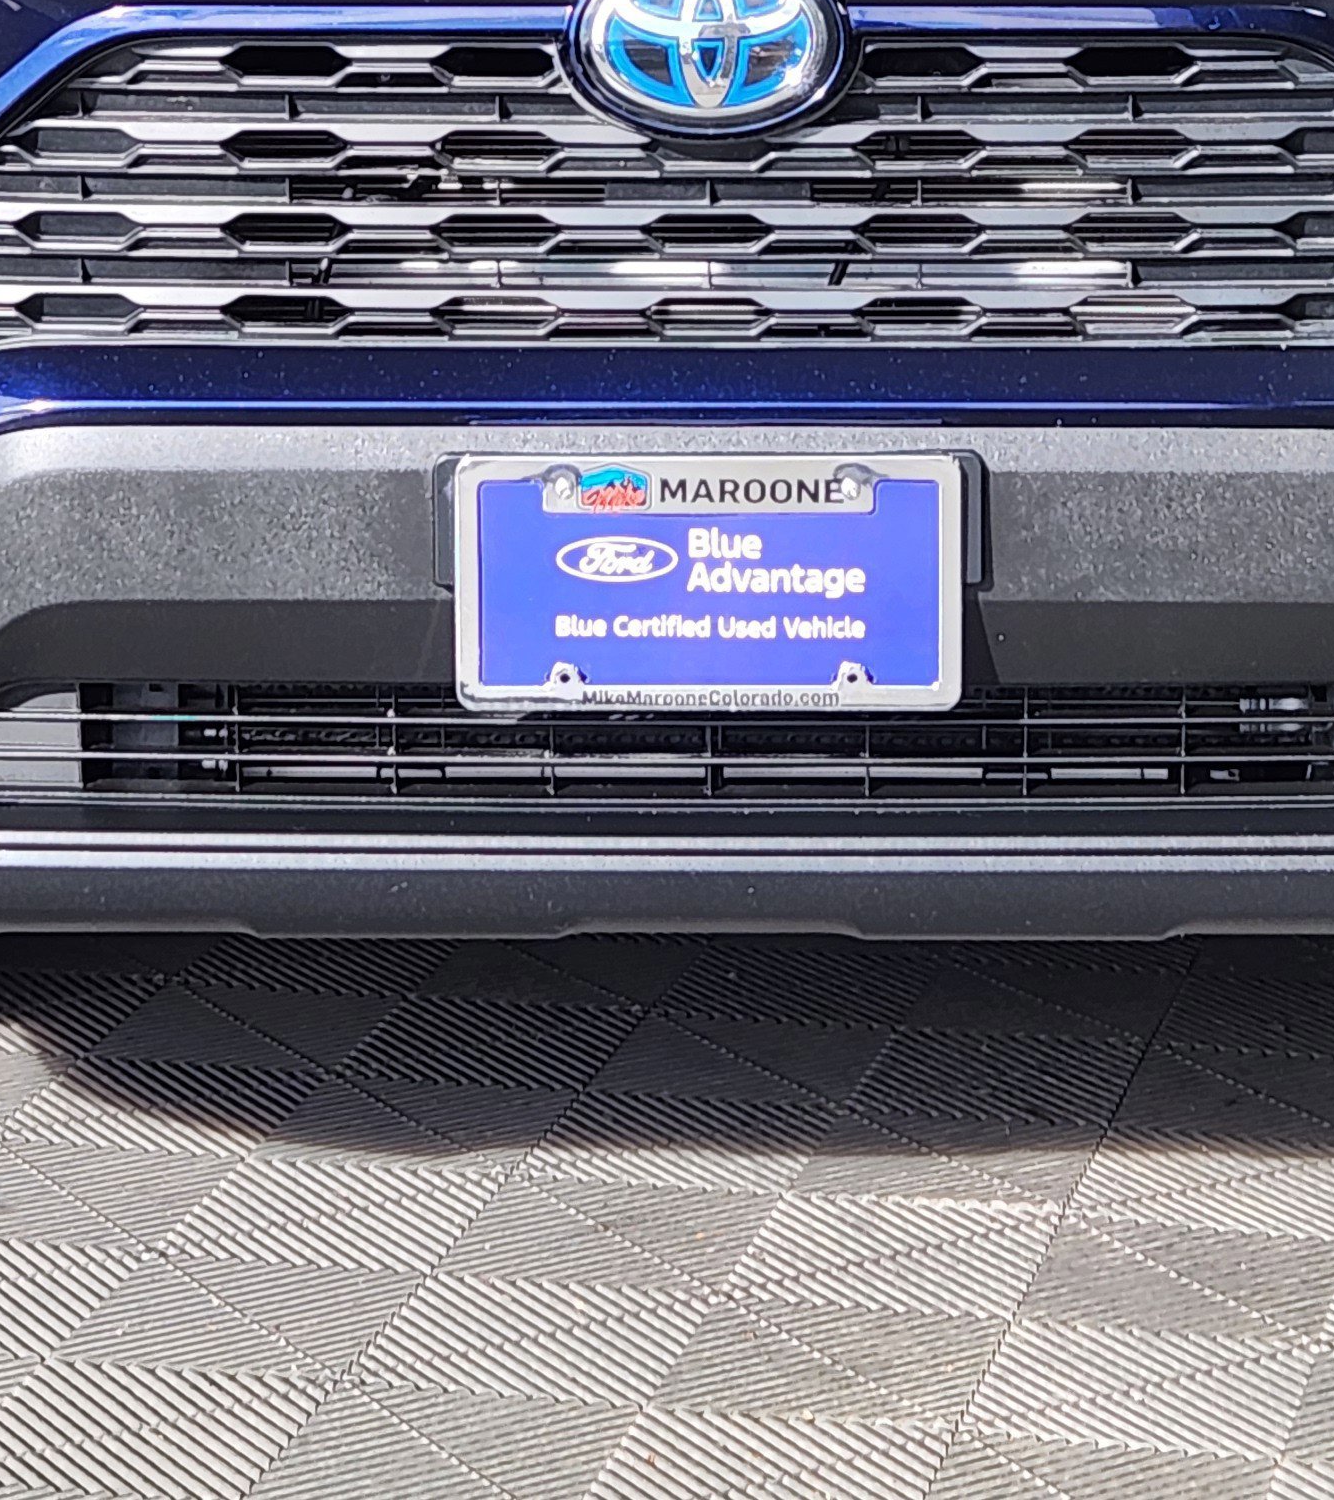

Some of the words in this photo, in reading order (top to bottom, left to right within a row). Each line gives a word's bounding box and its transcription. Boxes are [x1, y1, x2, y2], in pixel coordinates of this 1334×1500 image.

[659, 477, 845, 504] MAROONE
[687, 526, 763, 560] Blue
[579, 542, 656, 575] Ford
[686, 560, 867, 599] Advantage
[554, 614, 608, 638] Blue
[612, 614, 712, 639] Certified
[718, 615, 777, 639] Used
[782, 614, 866, 639] Vehicle
[582, 689, 840, 708] MikeMarooneColorado.com
